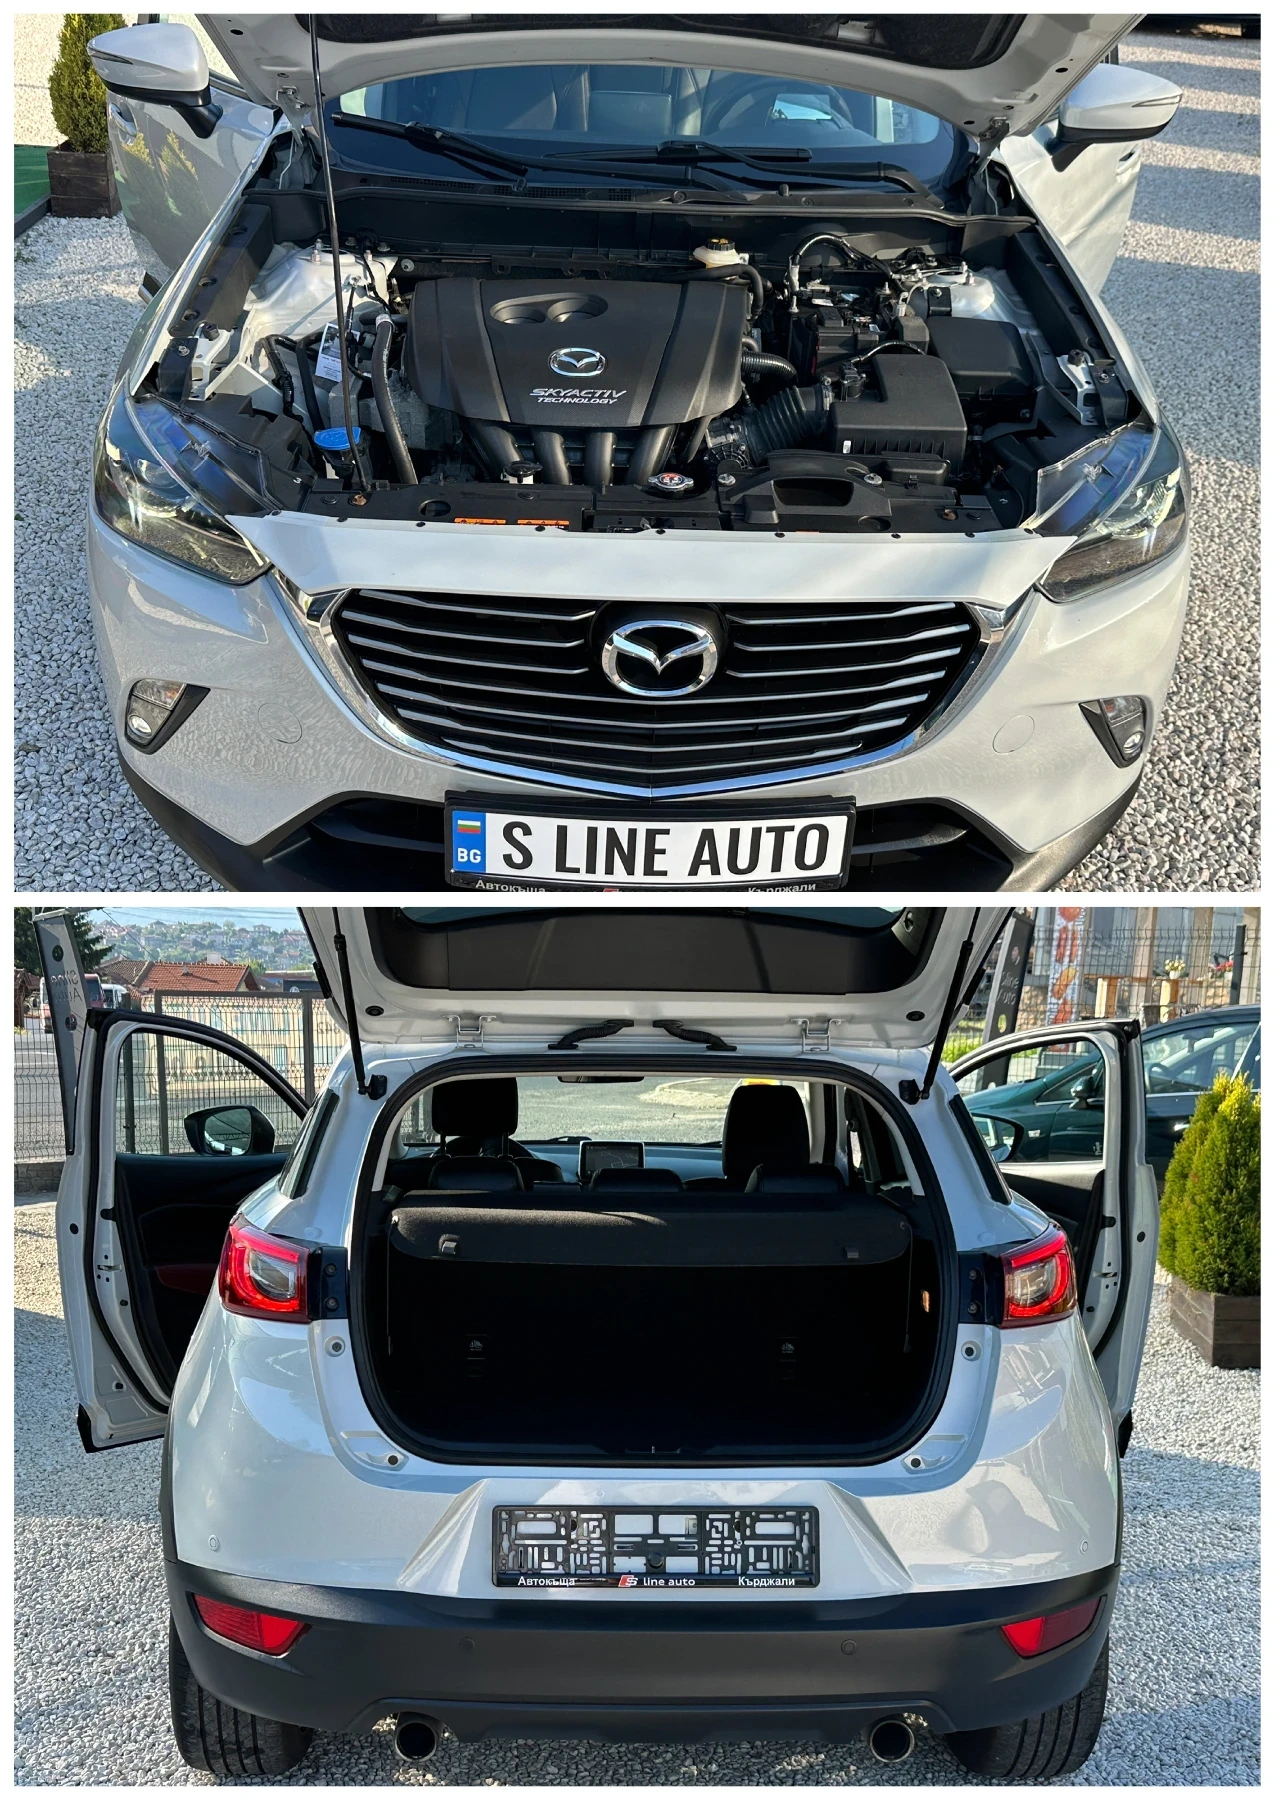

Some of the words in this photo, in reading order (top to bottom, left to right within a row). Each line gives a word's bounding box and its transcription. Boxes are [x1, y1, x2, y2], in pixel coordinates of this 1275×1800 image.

[529, 388, 627, 398] SKYACTIV
[537, 397, 617, 405] TECHNOLOGY
[502, 820, 533, 870] S
[555, 824, 671, 877] LINE
[688, 822, 830, 878] AUTO
[457, 847, 482, 864] BG
[517, 1576, 575, 1587] Автокъща
[643, 1577, 665, 1586] line
[668, 1577, 696, 1586] auto
[738, 1576, 795, 1587] Кърджали
